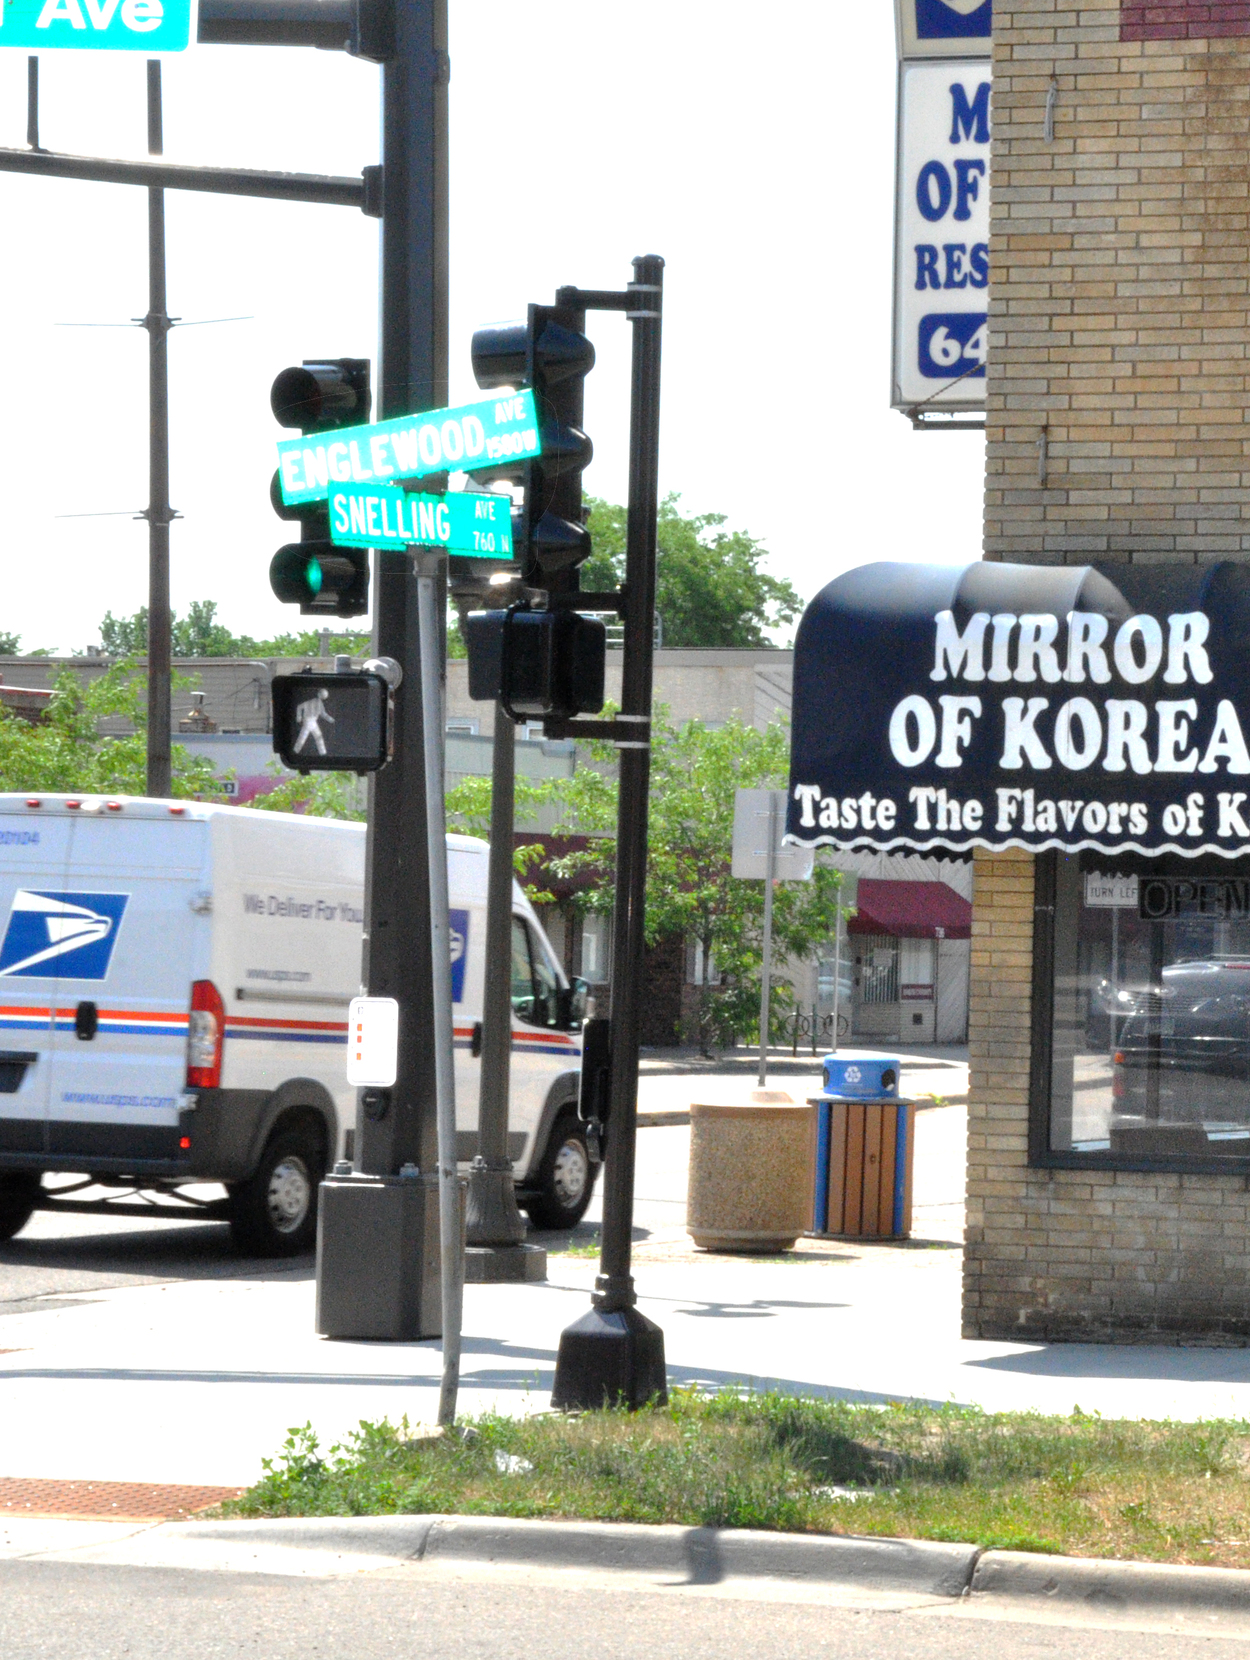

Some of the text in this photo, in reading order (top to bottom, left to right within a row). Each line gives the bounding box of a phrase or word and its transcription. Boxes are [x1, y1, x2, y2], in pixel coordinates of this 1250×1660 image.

[36, 0, 164, 32] Ave
[916, 159, 985, 222] OF
[495, 397, 526, 424] AVE
[281, 416, 485, 492] ENGLEWOOD
[333, 494, 450, 541] SNELLING
[475, 500, 496, 521] AVE
[473, 531, 510, 552] 760 N
[930, 610, 1214, 685] MIRROR
[888, 695, 982, 768] OF
[794, 784, 896, 831] Taste
[909, 786, 983, 829] The
[995, 787, 1147, 835] Flavors
[1162, 792, 1204, 837] of
[243, 894, 265, 915] We
[267, 895, 313, 919] Deliver
[315, 899, 337, 920] For
[1090, 887, 1138, 899] TURN LEF
